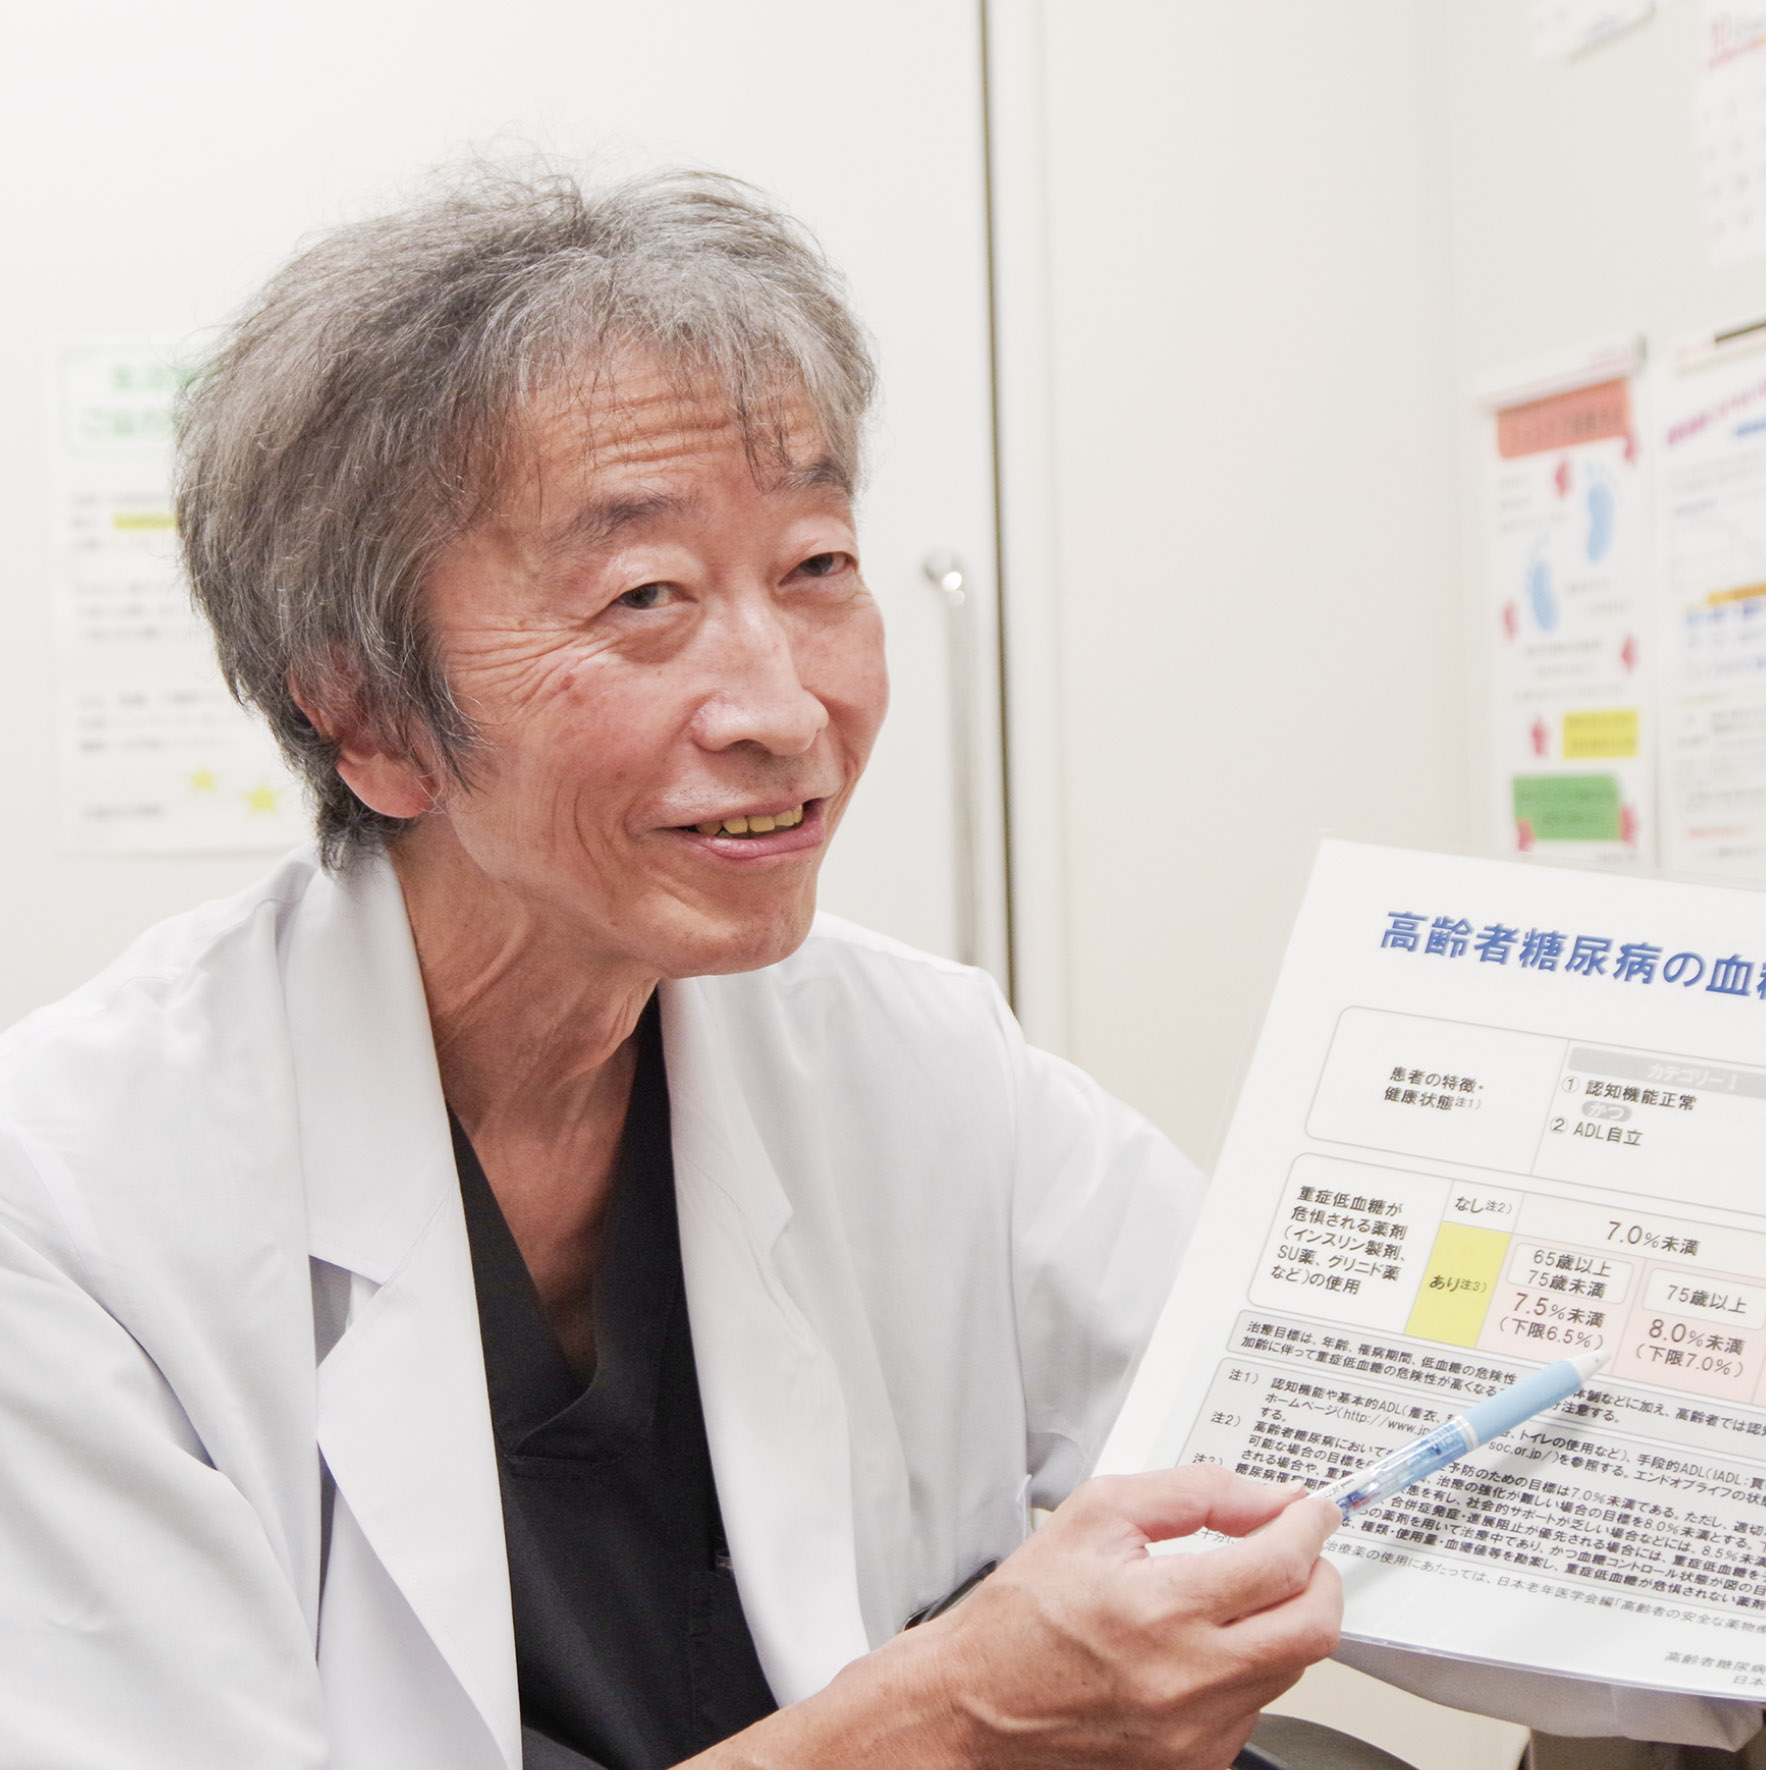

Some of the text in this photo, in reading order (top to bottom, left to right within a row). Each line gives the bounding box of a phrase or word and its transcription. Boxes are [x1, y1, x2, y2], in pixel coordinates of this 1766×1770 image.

[1380, 911, 1766, 1000] 高齢者糖尿病の血
[1584, 1079, 1697, 1112] 認知機能正常
[1588, 1102, 1626, 1120] かつ
[1573, 1120, 1644, 1146] ADL自立
[1297, 1185, 1404, 1217] 重症低血糖が
[1290, 1205, 1408, 1241] 危惧される薬剤
[1277, 1244, 1401, 1281] SU薬、グリニド薬
[1533, 1249, 1612, 1278] 65歳以上
[1528, 1269, 1608, 1299] 75歳未満
[1667, 1284, 1747, 1314] 75歳以上
[1240, 1336, 1506, 1398] 加齢に伴って重症低血糖の危険性が高くなる
[1260, 1406, 1287, 1423] する。
